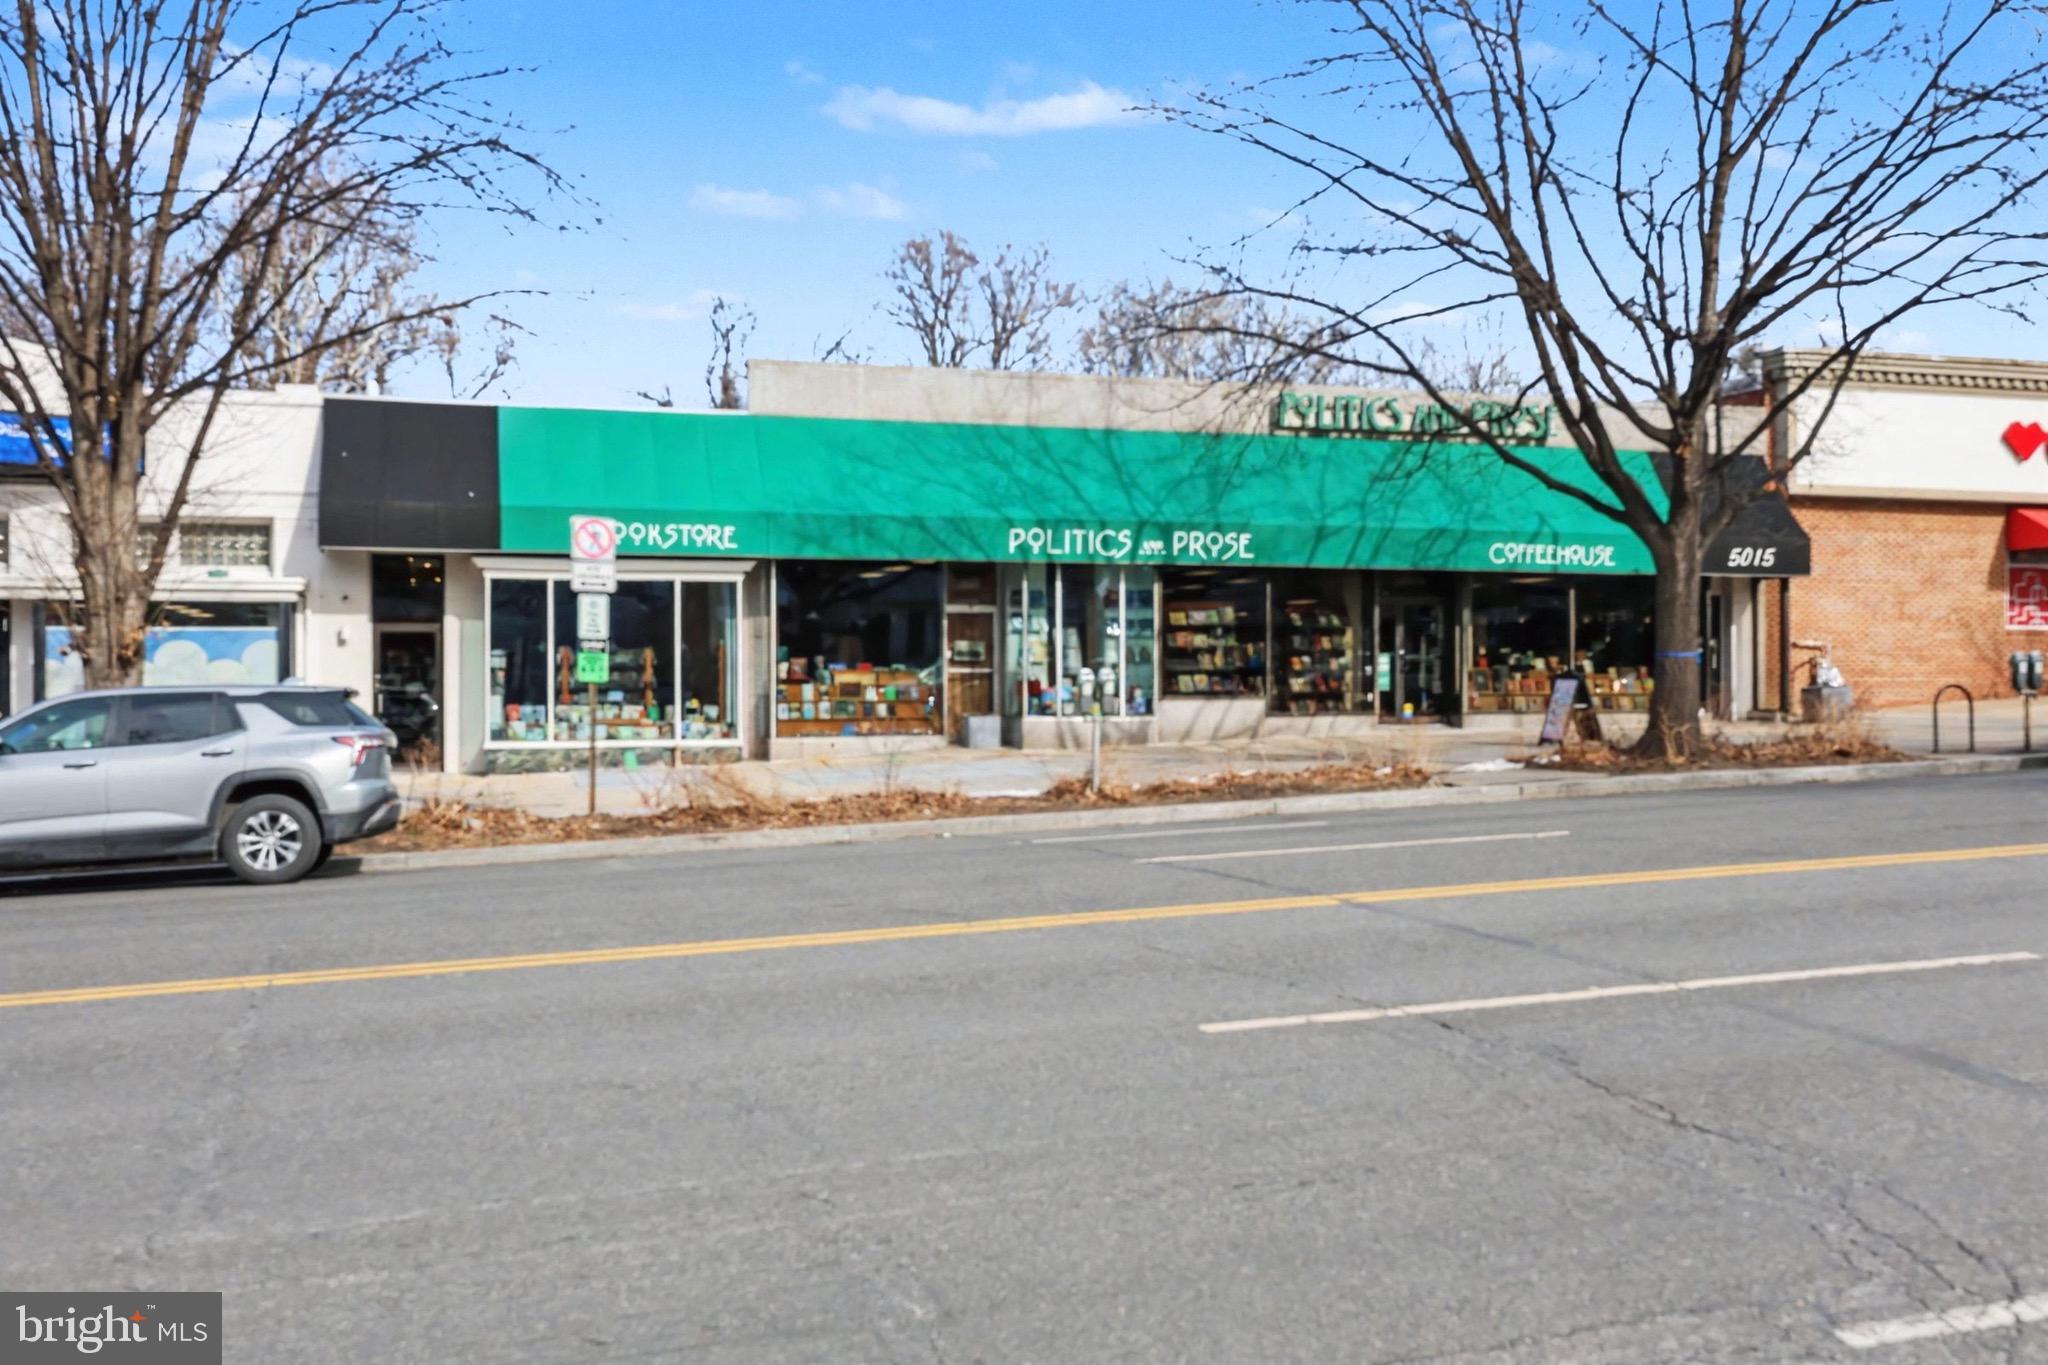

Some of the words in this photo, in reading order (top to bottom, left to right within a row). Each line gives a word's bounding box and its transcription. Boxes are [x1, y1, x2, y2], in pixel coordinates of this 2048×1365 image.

[614, 522, 738, 550] OOKSTORE
[1008, 527, 1132, 559] POLITICS
[1172, 531, 1255, 560] PROSE
[1488, 542, 1616, 567] COFFEEHOUSE
[1727, 547, 1776, 567] 5015
